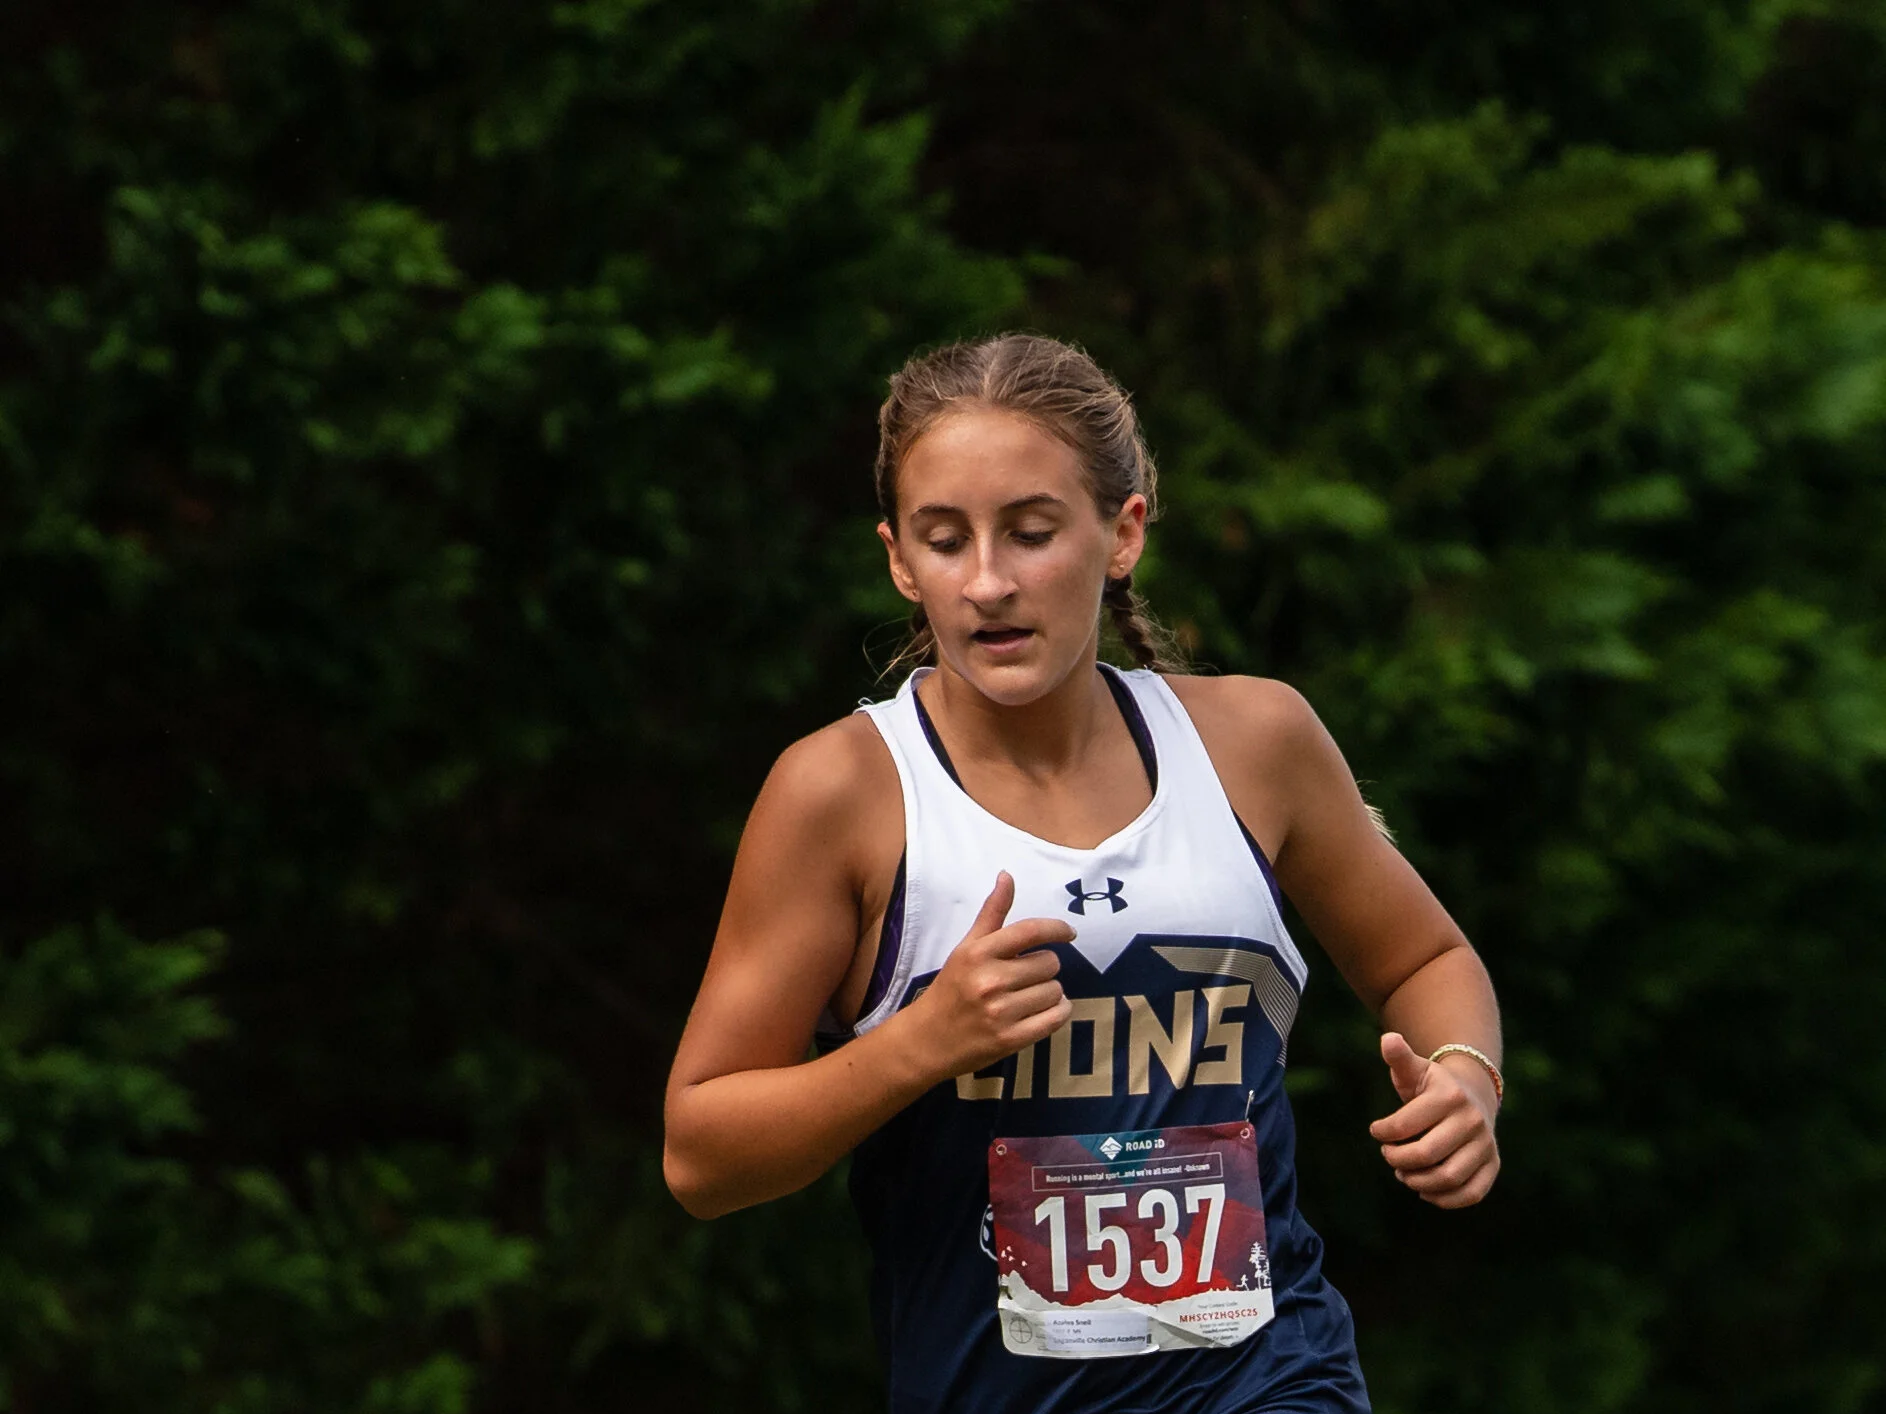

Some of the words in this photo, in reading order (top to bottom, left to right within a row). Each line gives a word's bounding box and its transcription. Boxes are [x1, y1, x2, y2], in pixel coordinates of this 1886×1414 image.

[1125, 1140, 1152, 1151] ROAD
[1045, 1174, 1071, 1183] Running
[1083, 1172, 1104, 1181] mental
[1153, 1167, 1161, 1175] all
[1034, 1184, 1226, 1292] 1537
[1086, 1336, 1116, 1344] Christian
[1116, 1335, 1146, 1343] Academy
